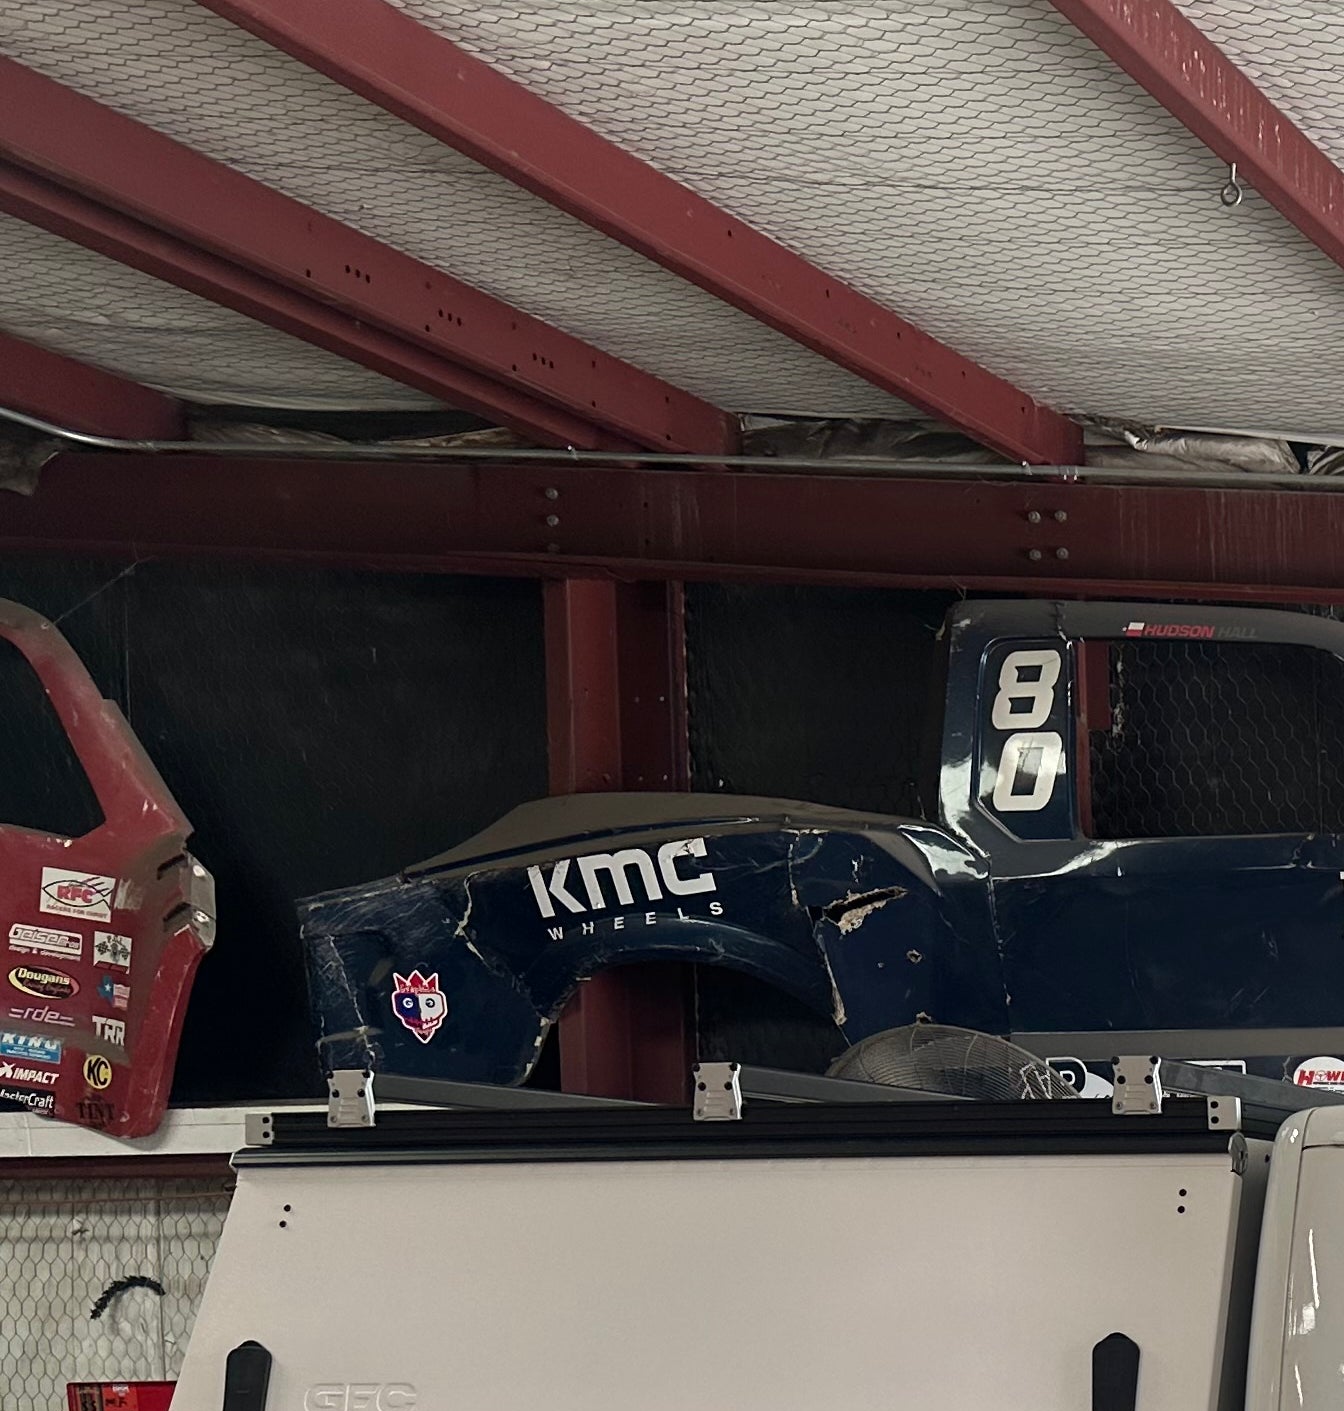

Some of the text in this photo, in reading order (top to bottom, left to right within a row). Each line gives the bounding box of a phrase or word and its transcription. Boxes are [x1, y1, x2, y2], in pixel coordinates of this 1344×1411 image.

[1145, 624, 1258, 638] HUDSON HALL
[57, 885, 93, 903] RFC
[547, 901, 724, 940] WHEELS
[18, 967, 70, 985] Dougans
[13, 1067, 59, 1085] IMPACT
[86, 1057, 109, 1086] KC
